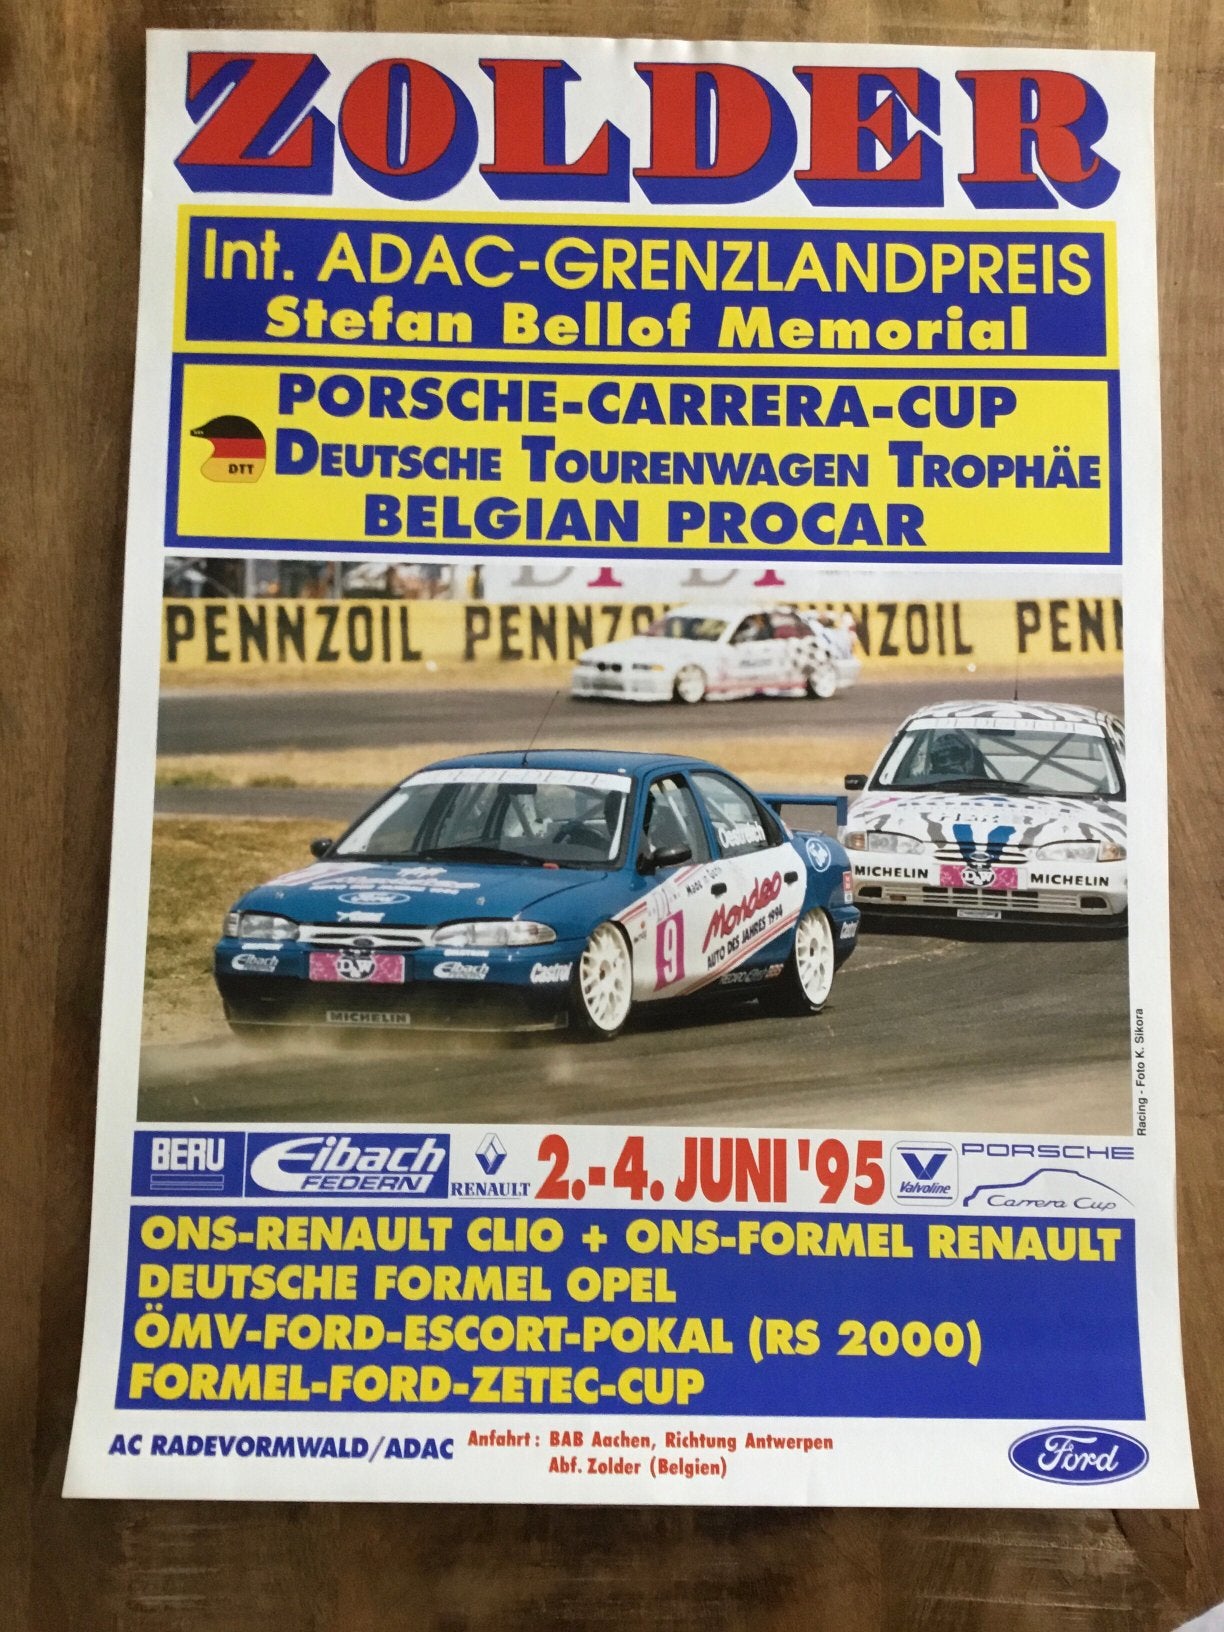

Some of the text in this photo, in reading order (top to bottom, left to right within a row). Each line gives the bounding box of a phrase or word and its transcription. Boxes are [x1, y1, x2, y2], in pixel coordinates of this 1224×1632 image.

[173, 51, 1121, 210] ZOLDER
[204, 228, 1092, 296] Int. ADAC-GRENZLANDPREIS
[265, 294, 1028, 351] Stefan Bellof Memorial
[277, 372, 1017, 430] PORSCHE-CARRERA-CUP
[228, 463, 254, 475] DTT
[364, 493, 927, 547] BELGIAN PROCAR
[165, 604, 423, 663] PENNZOIL
[854, 865, 929, 879] MICHELIN
[1030, 873, 1110, 887] MICHELIN
[702, 871, 783, 954] Mondeo
[662, 918, 678, 983] 9
[707, 904, 784, 970] AUTO DES JAHRES 1994
[329, 1012, 408, 1024] MICHELIN
[1134, 1008, 1145, 1044] Sikora
[1134, 1047, 1145, 1058] K.
[1135, 1061, 1146, 1087] Foto
[1136, 1097, 1149, 1136] Racing
[151, 1136, 226, 1172] BERU
[250, 1135, 447, 1193] Eibach
[961, 1143, 1135, 1160] PORSCHE
[299, 1174, 423, 1193] FEDERN
[674, 1136, 788, 1204] JUNI
[797, 1138, 886, 1206] '95
[899, 1181, 951, 1196] Valvoline
[451, 1181, 531, 1198] RENAULT
[987, 1194, 1117, 1212] Carrera Cup
[140, 1214, 1122, 1262] ONS-RENAULT CLIO + ONS-FORMEL RENAULT
[137, 1263, 677, 1304] DEUTSCHE FORMEL OPEL
[134, 1302, 983, 1368] ÖMV-FORD-ESCORT-POKAL (RS 2000)
[128, 1361, 705, 1406] FORMEL-FORD-ZETEC-CUP
[107, 1433, 454, 1462] AC RADEVORMWALD/ADAC
[549, 1430, 584, 1447] BAB
[591, 1430, 657, 1451] Aachen,
[665, 1431, 737, 1453] Richtung
[744, 1432, 834, 1454] Antwerpen
[1037, 1437, 1118, 1472] Ford
[548, 1456, 728, 1479] Abf. Zolder (Belgien)
